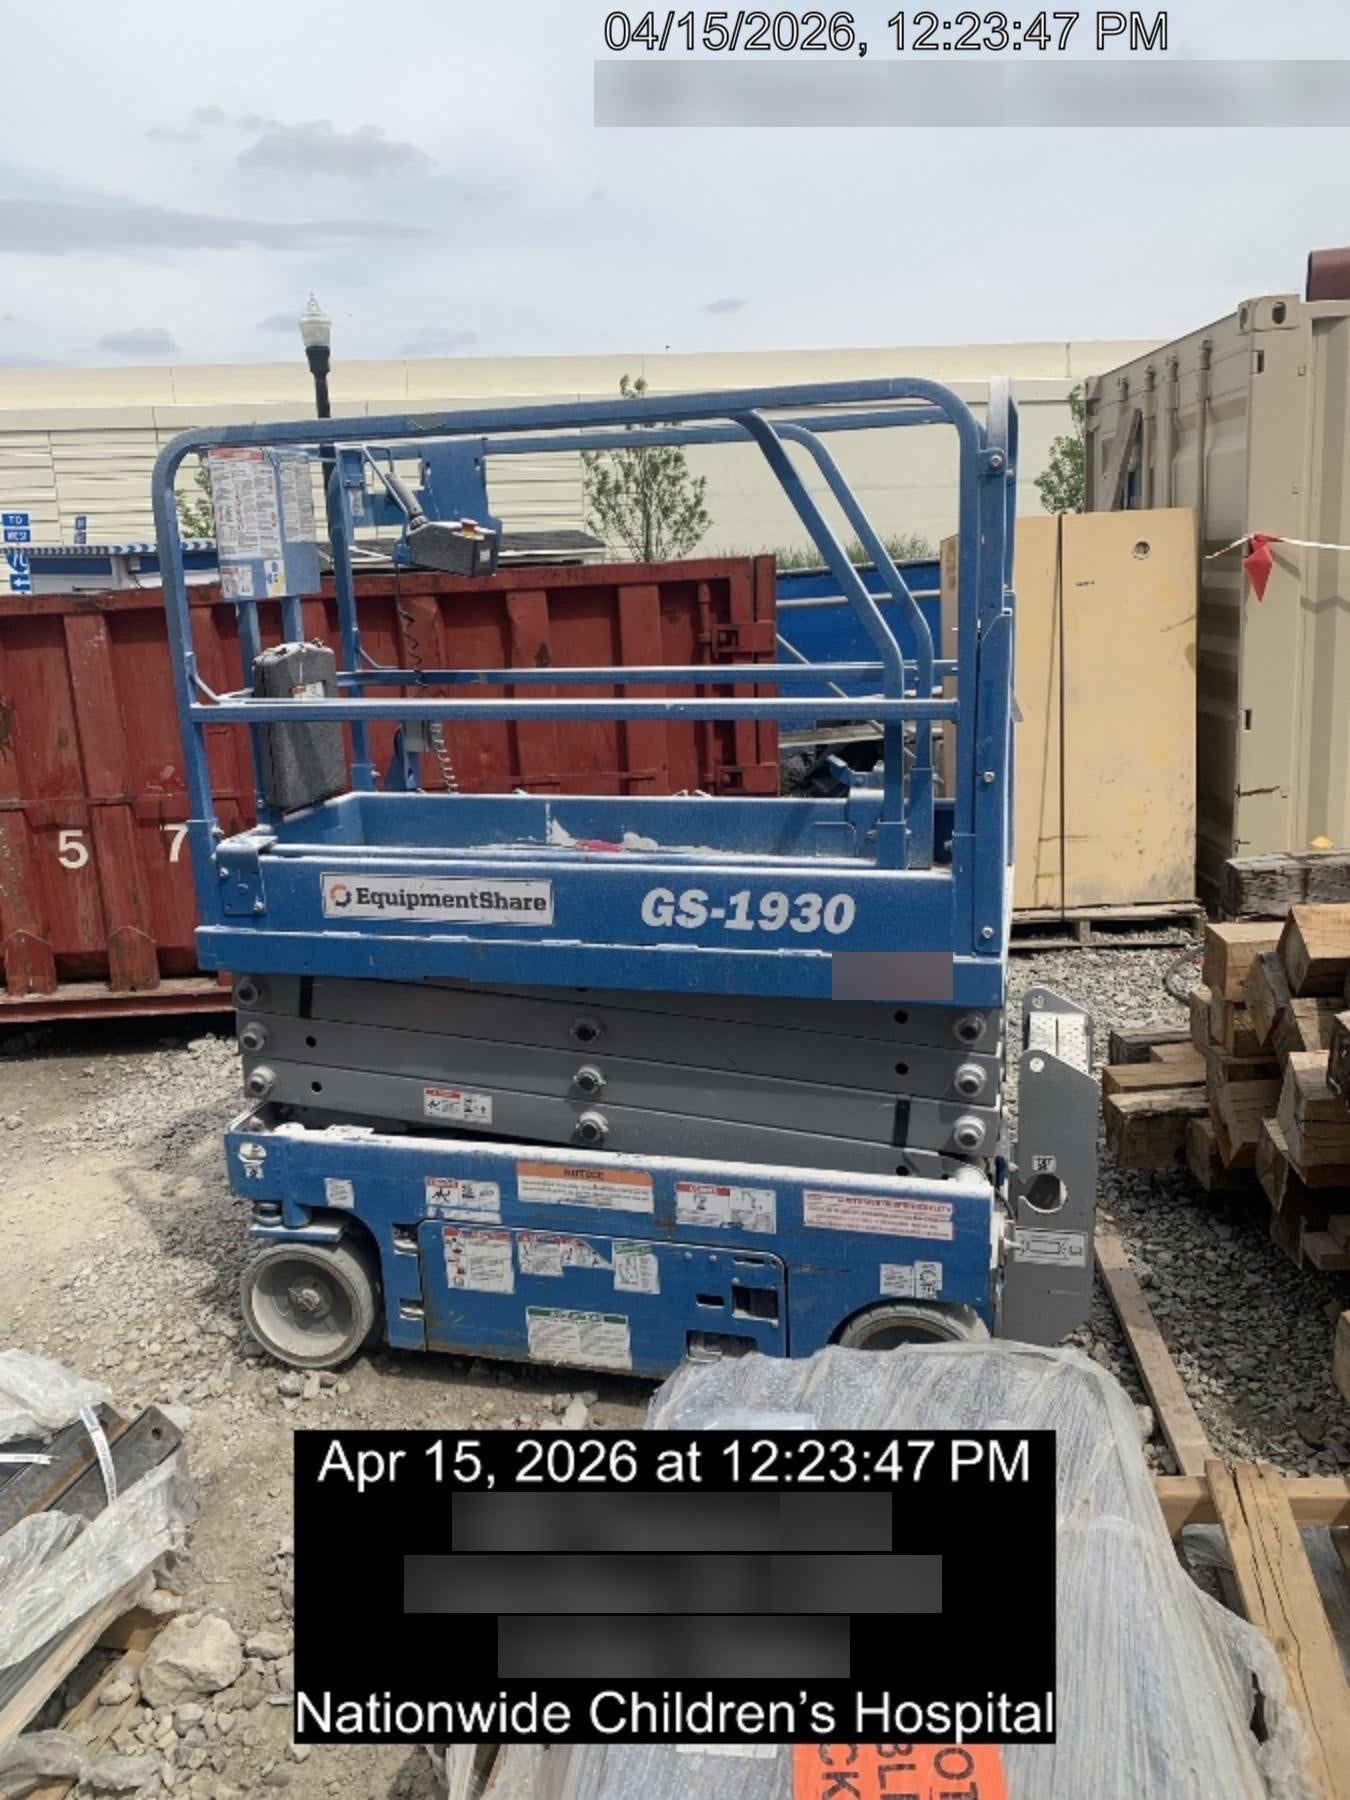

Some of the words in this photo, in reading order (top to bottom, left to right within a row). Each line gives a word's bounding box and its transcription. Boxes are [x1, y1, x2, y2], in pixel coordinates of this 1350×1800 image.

[58, 829, 89, 869] 5
[160, 824, 189, 863] 7
[355, 887, 548, 912] EquipmentShare
[640, 887, 857, 935] GS-1930
[818, 1744, 861, 1800] CK
[933, 1747, 979, 1800] OT
